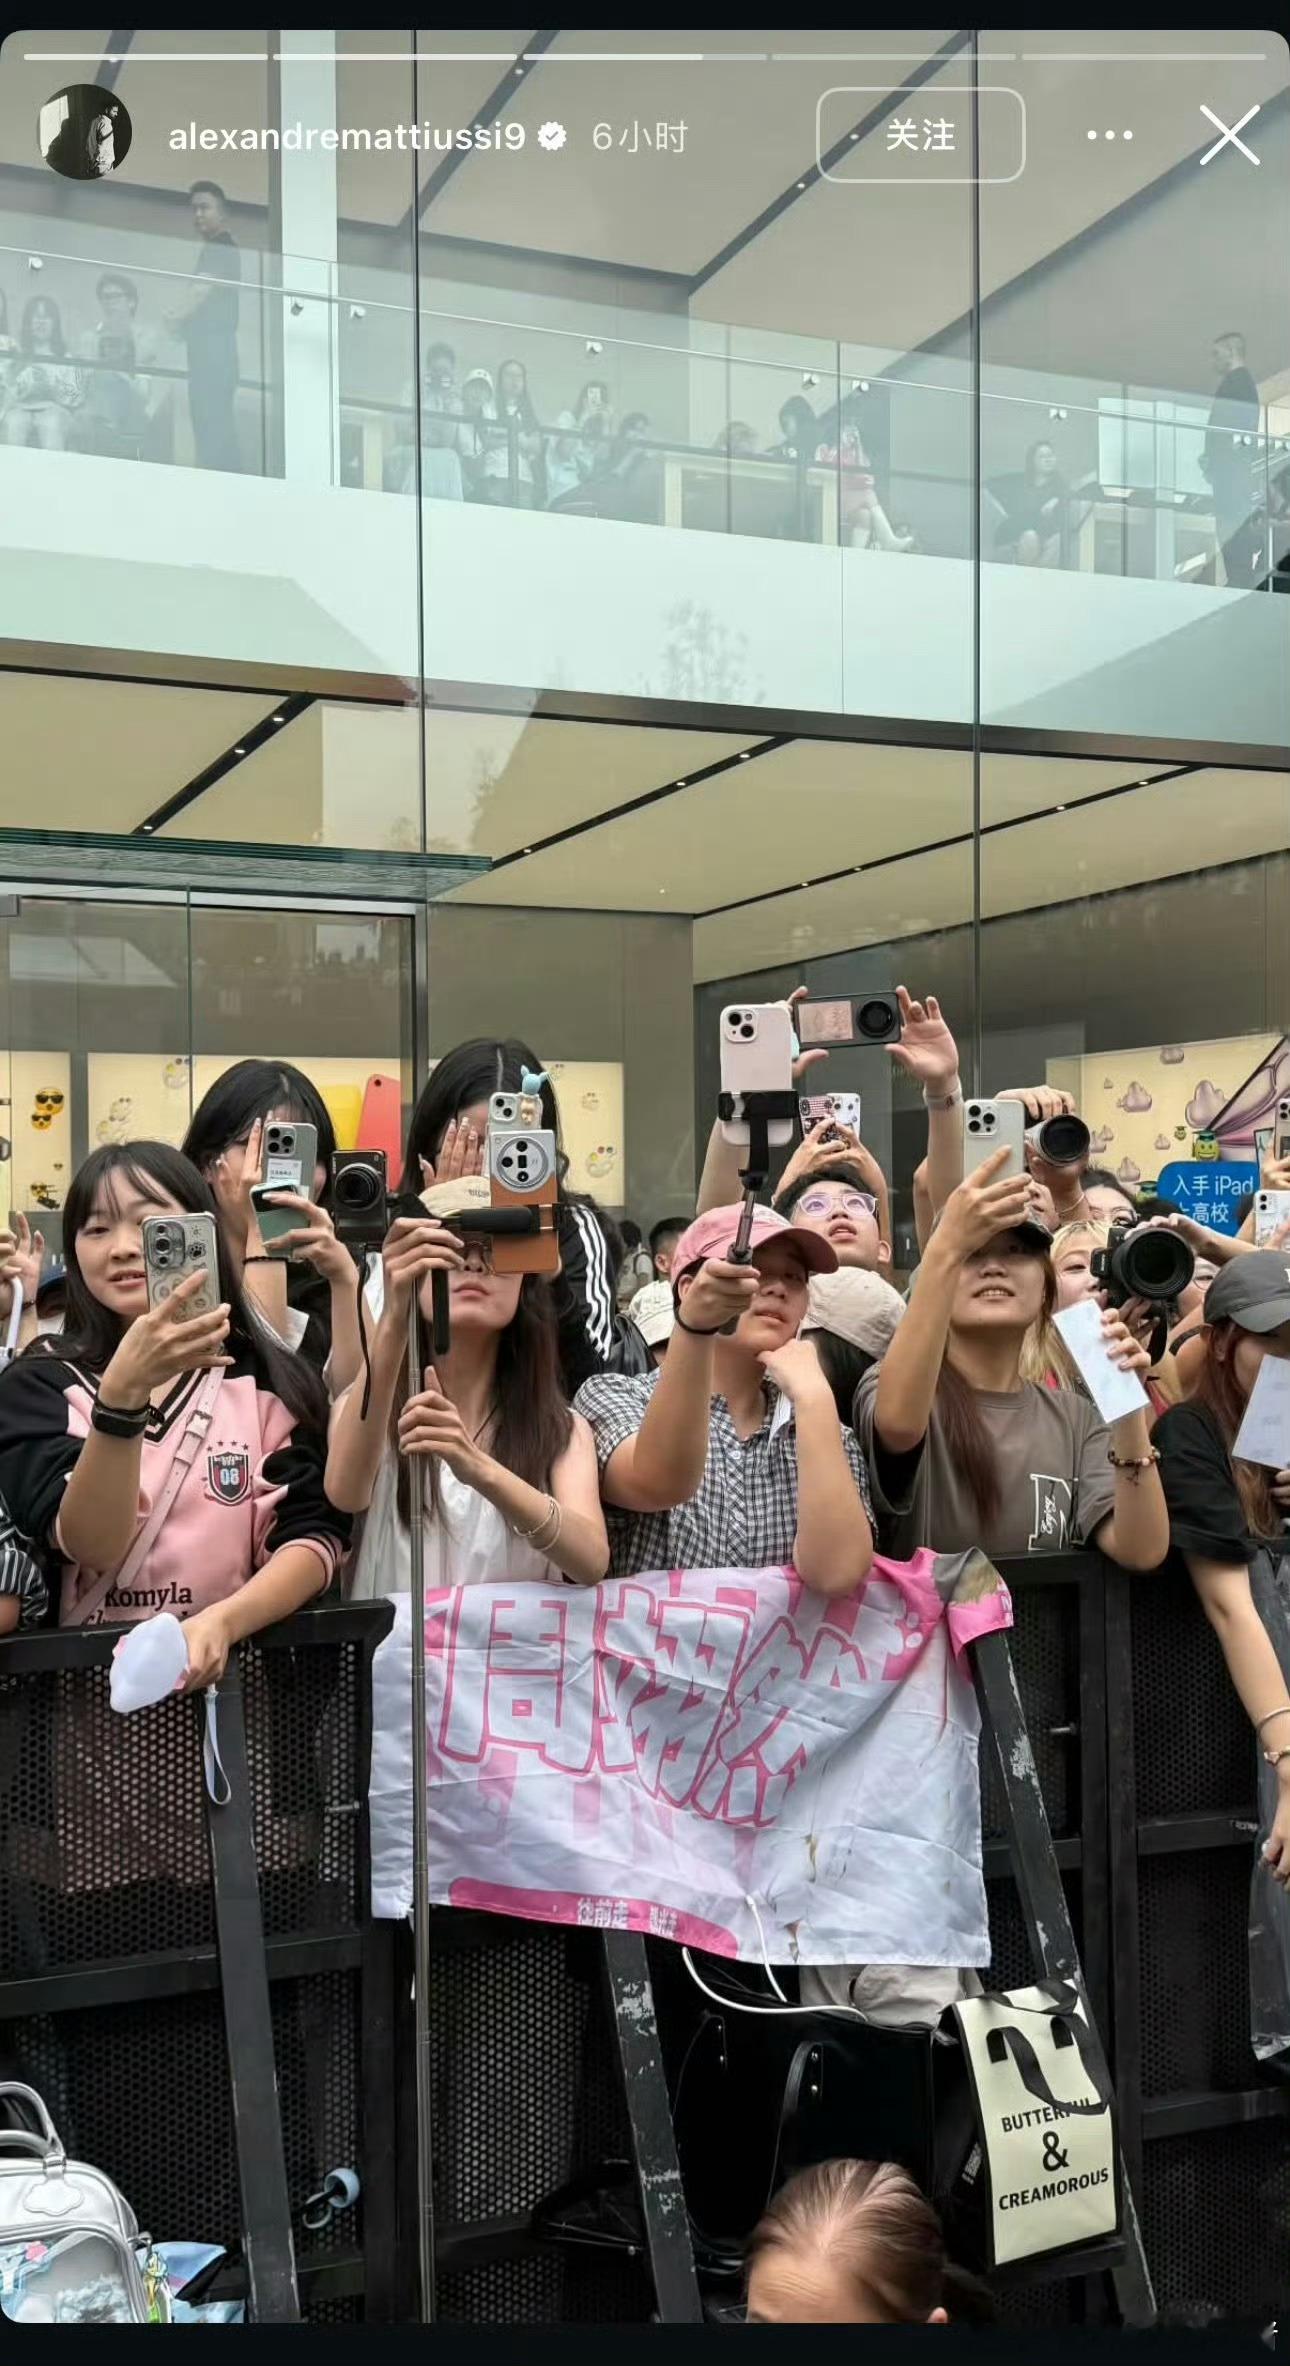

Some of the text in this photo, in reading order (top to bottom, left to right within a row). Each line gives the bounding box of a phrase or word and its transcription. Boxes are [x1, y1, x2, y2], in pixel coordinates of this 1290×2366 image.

[1172, 1174, 1254, 1197] 入手 iPad
[1042, 2130, 1070, 2172] &
[999, 2167, 1109, 2211] CREAMOROUS
